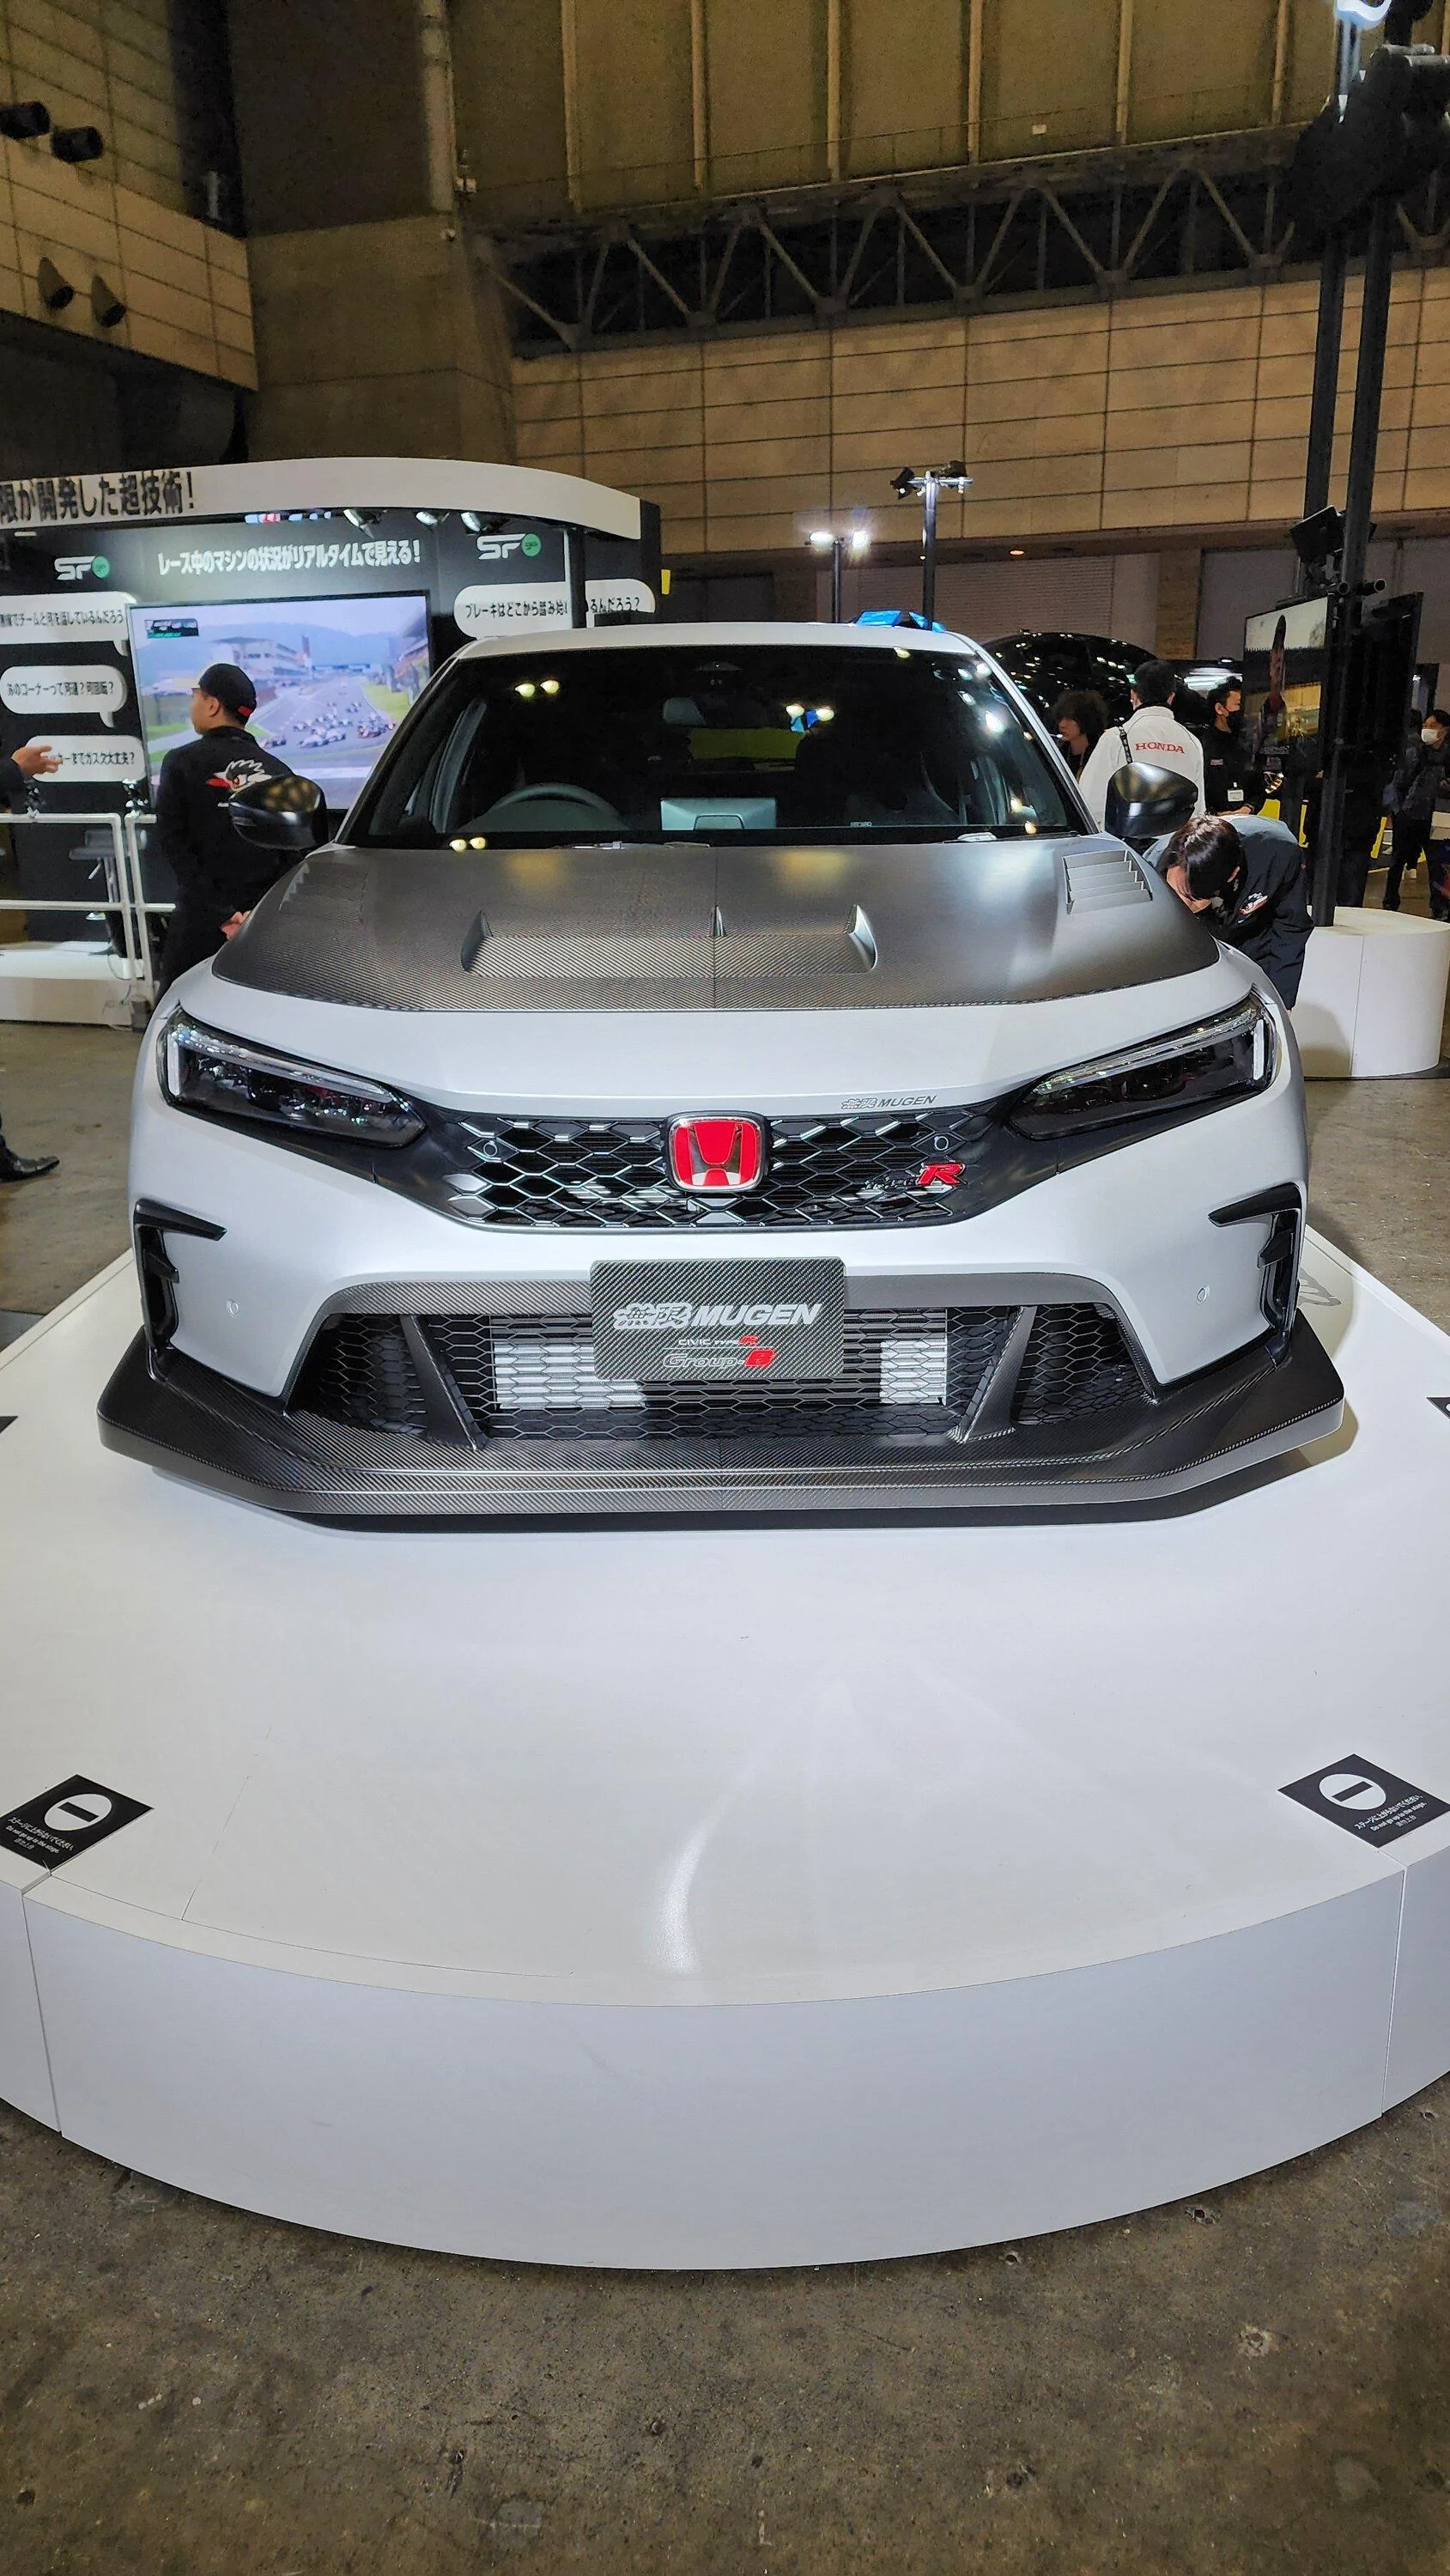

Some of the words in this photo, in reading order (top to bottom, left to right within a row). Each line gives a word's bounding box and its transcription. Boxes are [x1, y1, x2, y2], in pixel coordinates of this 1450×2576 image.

[1134, 741, 1185, 754] HONDA
[877, 1095, 937, 1108] MUGEN
[690, 1303, 822, 1327] MUGEN
